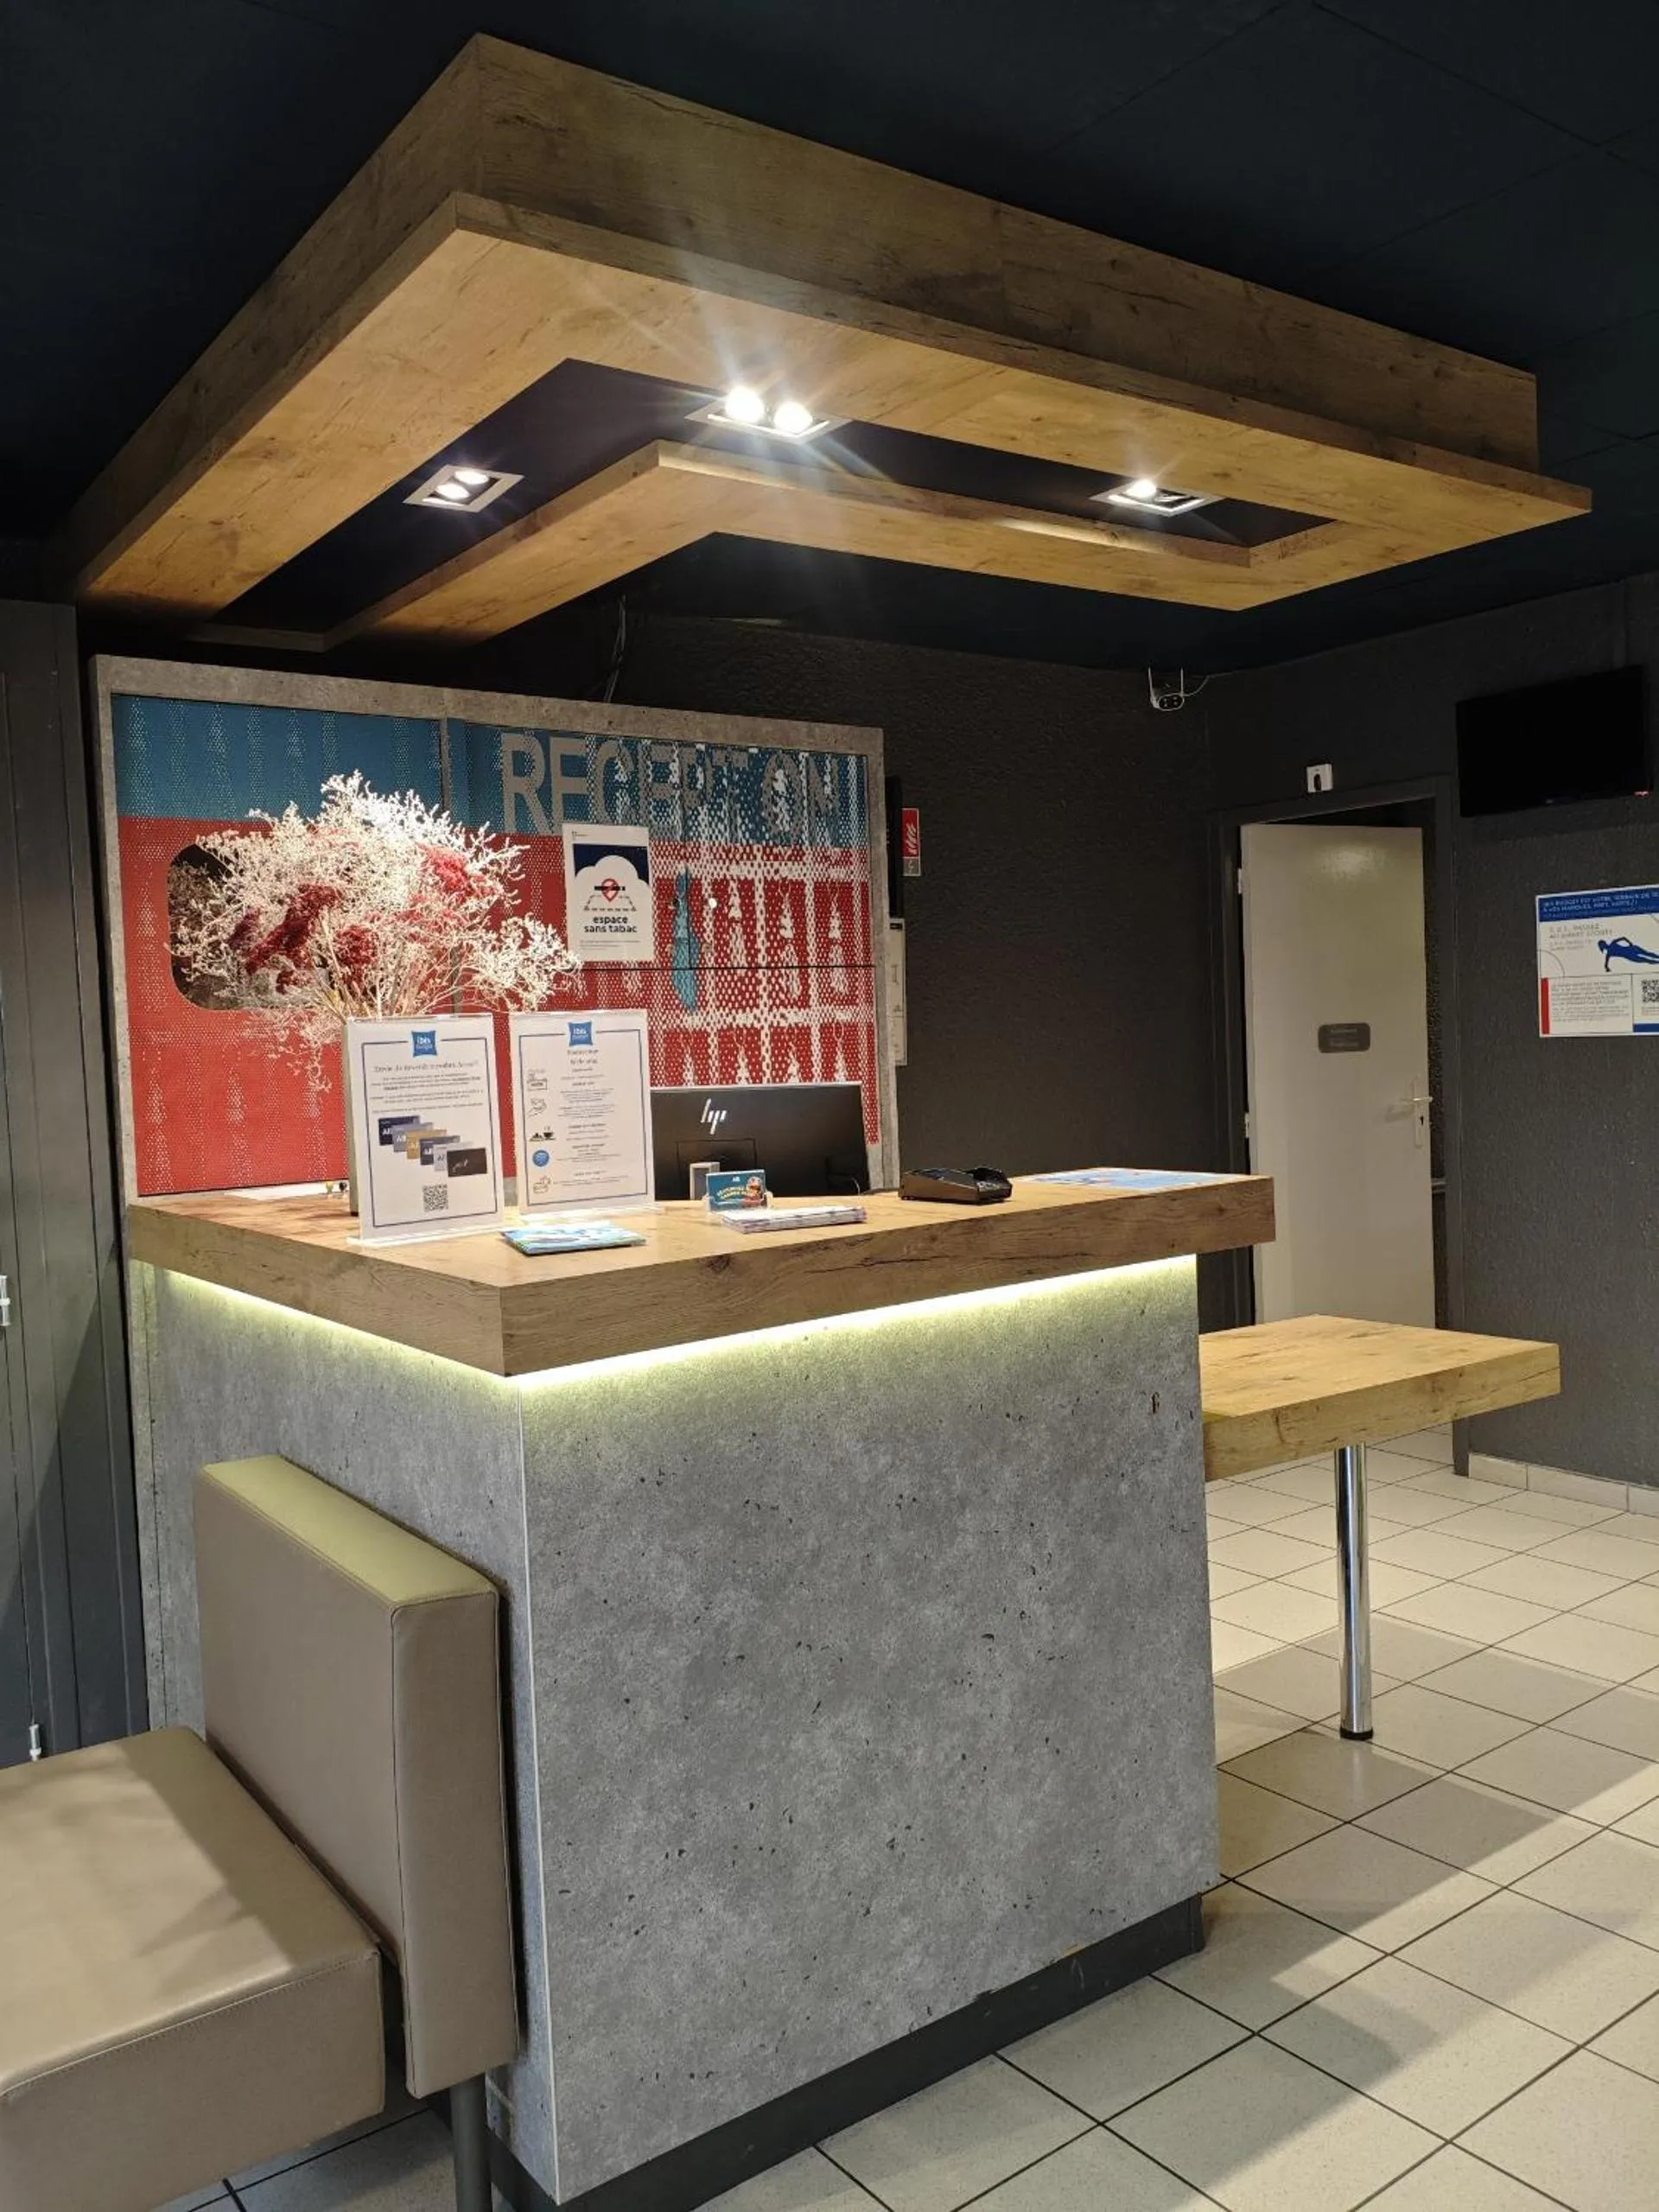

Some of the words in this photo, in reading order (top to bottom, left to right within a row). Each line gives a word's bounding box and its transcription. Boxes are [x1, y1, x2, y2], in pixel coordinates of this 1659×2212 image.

[499, 733, 841, 845] RECEPTON
[593, 916, 629, 925] espace
[609, 925, 638, 933] tabac
[700, 1098, 728, 1135] hp
